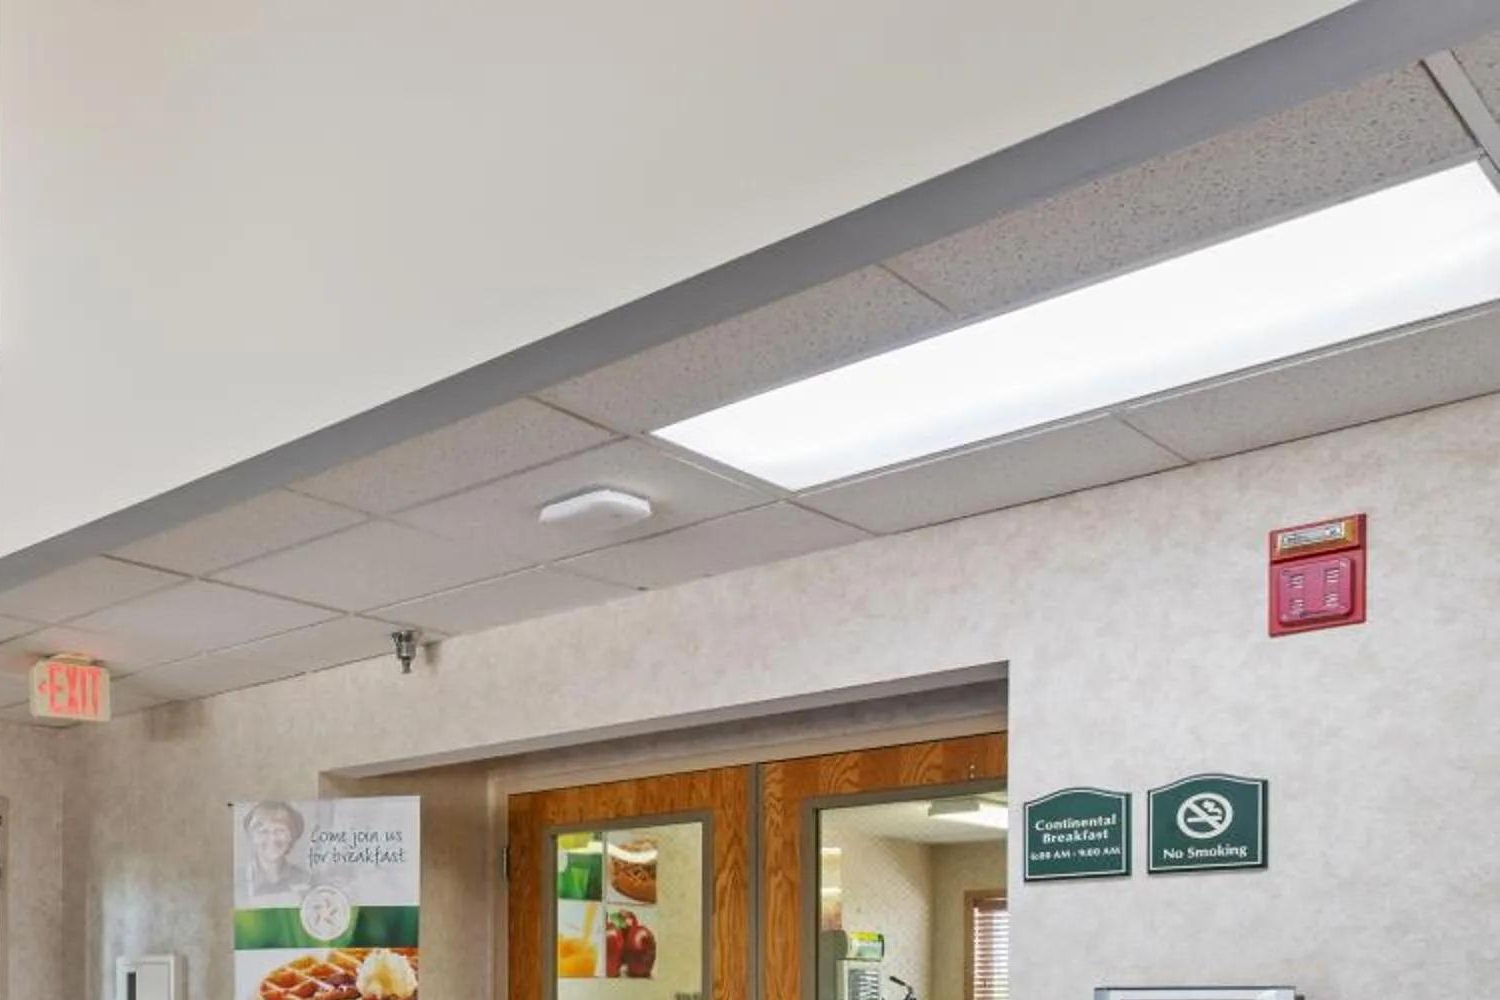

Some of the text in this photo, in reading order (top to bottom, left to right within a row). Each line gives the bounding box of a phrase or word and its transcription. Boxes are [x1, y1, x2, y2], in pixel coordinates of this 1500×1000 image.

[49, 663, 101, 717] EXIT
[1035, 813, 1117, 831] Continental
[310, 825, 403, 849] Come join us
[1042, 829, 1108, 844] Breakfast
[308, 847, 405, 868] for breakfast
[1053, 850, 1071, 859] AM
[1103, 846, 1121, 855] AM
[1163, 844, 1247, 859] No Smoking
